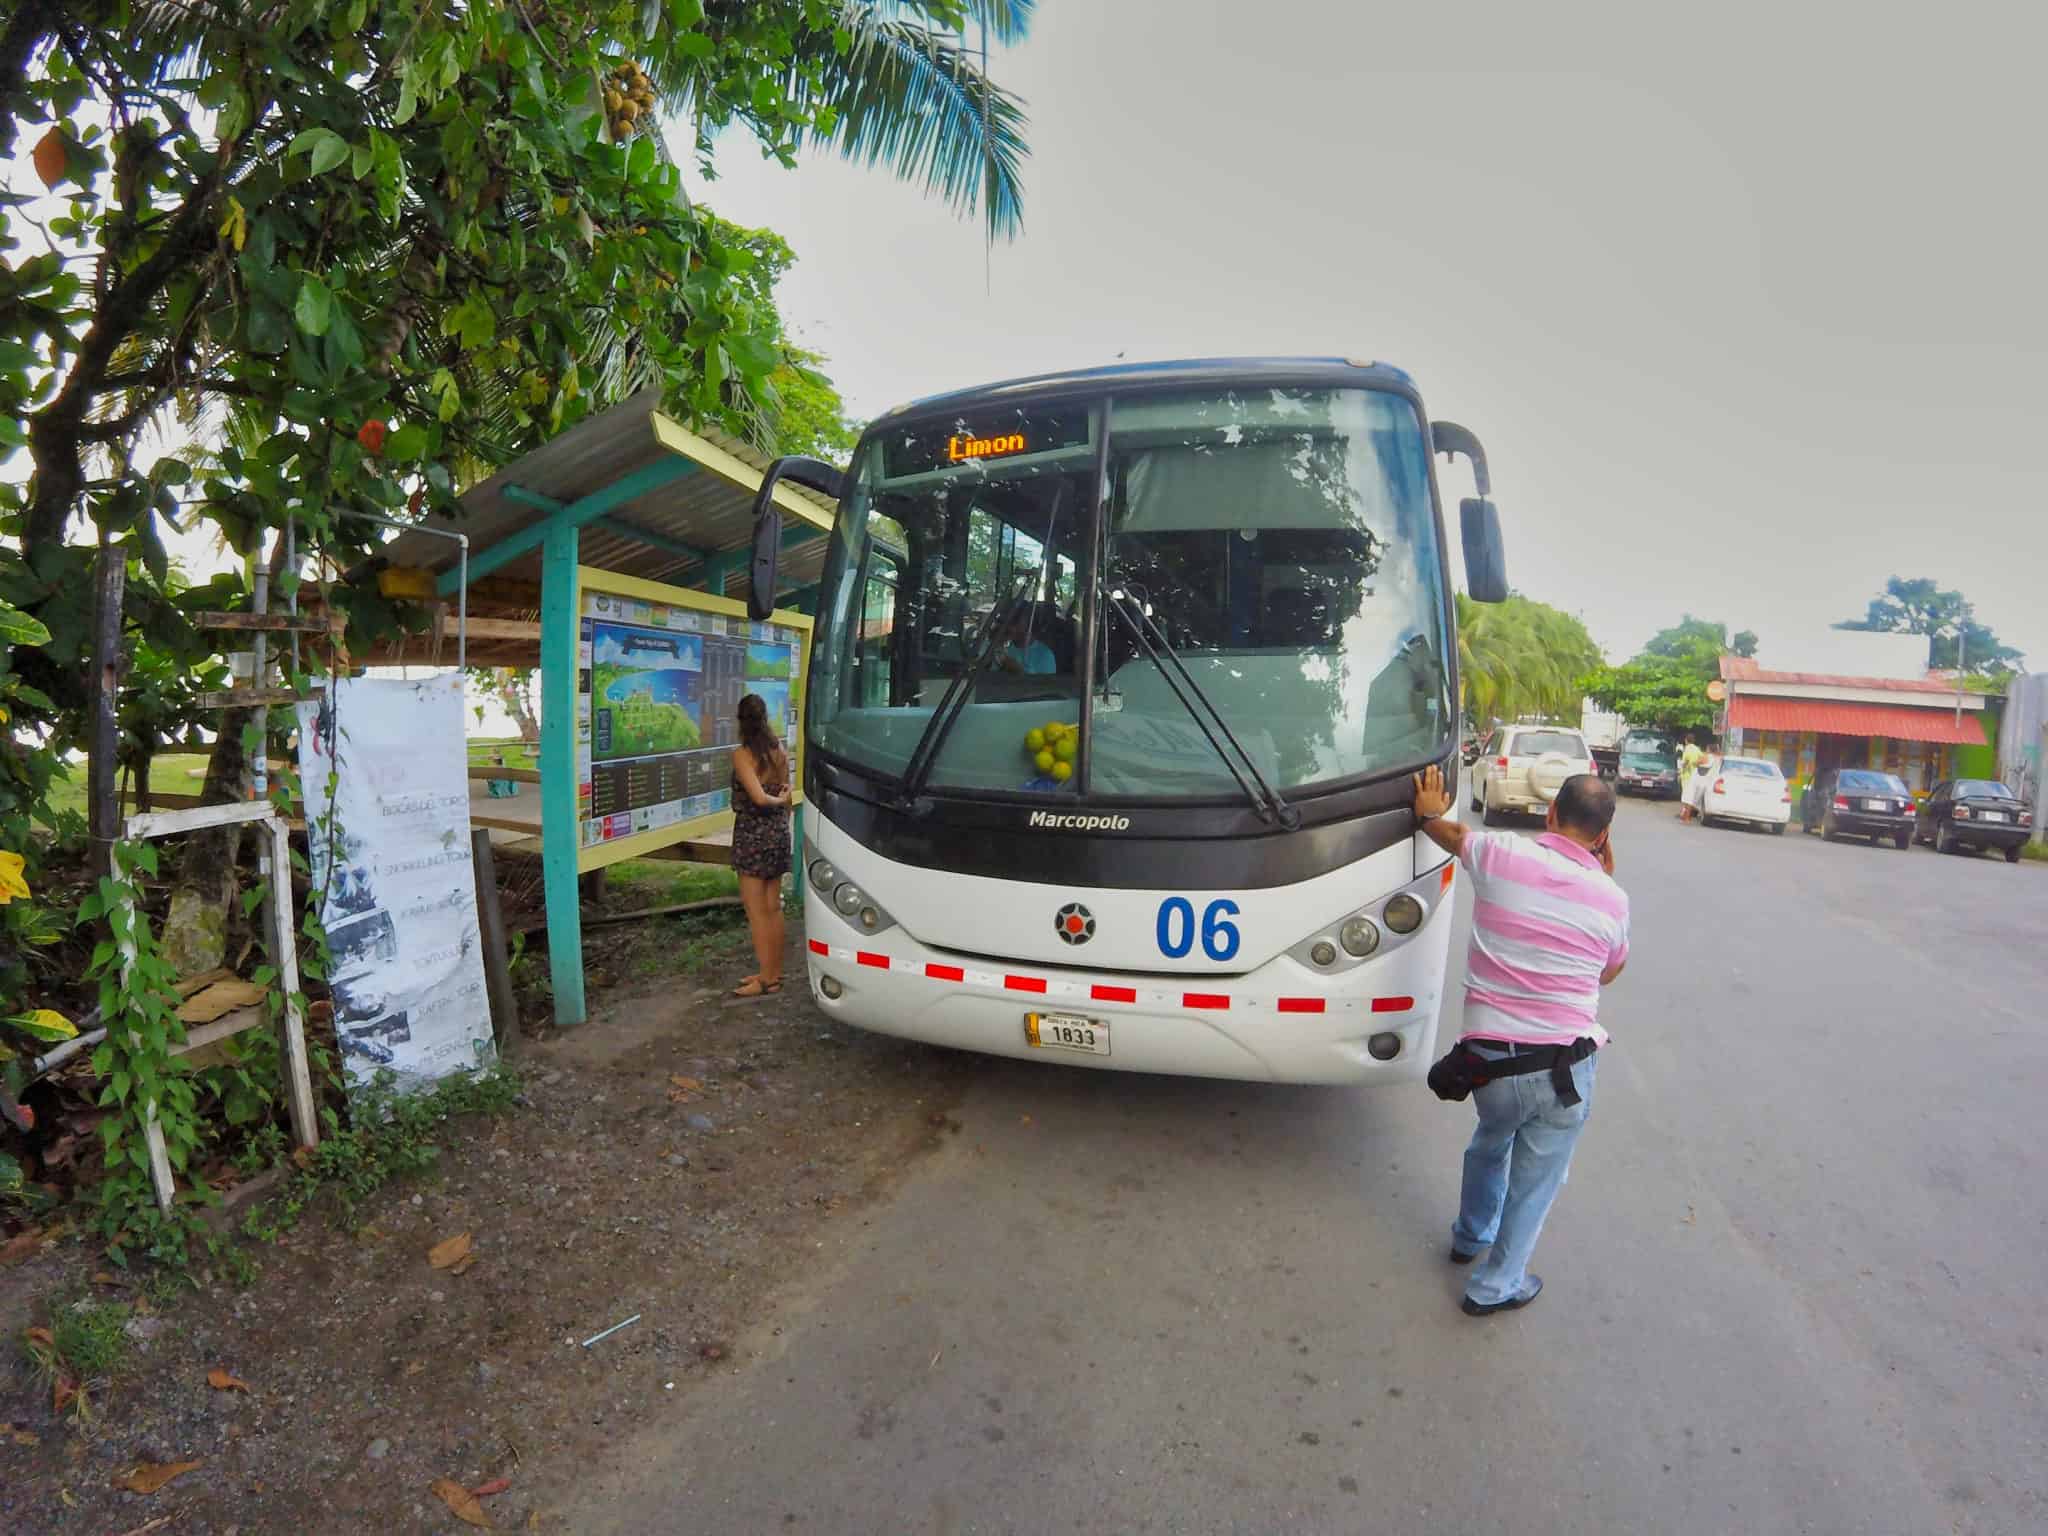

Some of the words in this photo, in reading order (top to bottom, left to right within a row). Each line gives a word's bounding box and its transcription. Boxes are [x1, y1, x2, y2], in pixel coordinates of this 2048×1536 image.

[949, 433, 1024, 459] Limon
[1029, 811, 1130, 831] Marcopolo
[1156, 896, 1241, 962] 06
[1052, 1026, 1095, 1046] 1833
